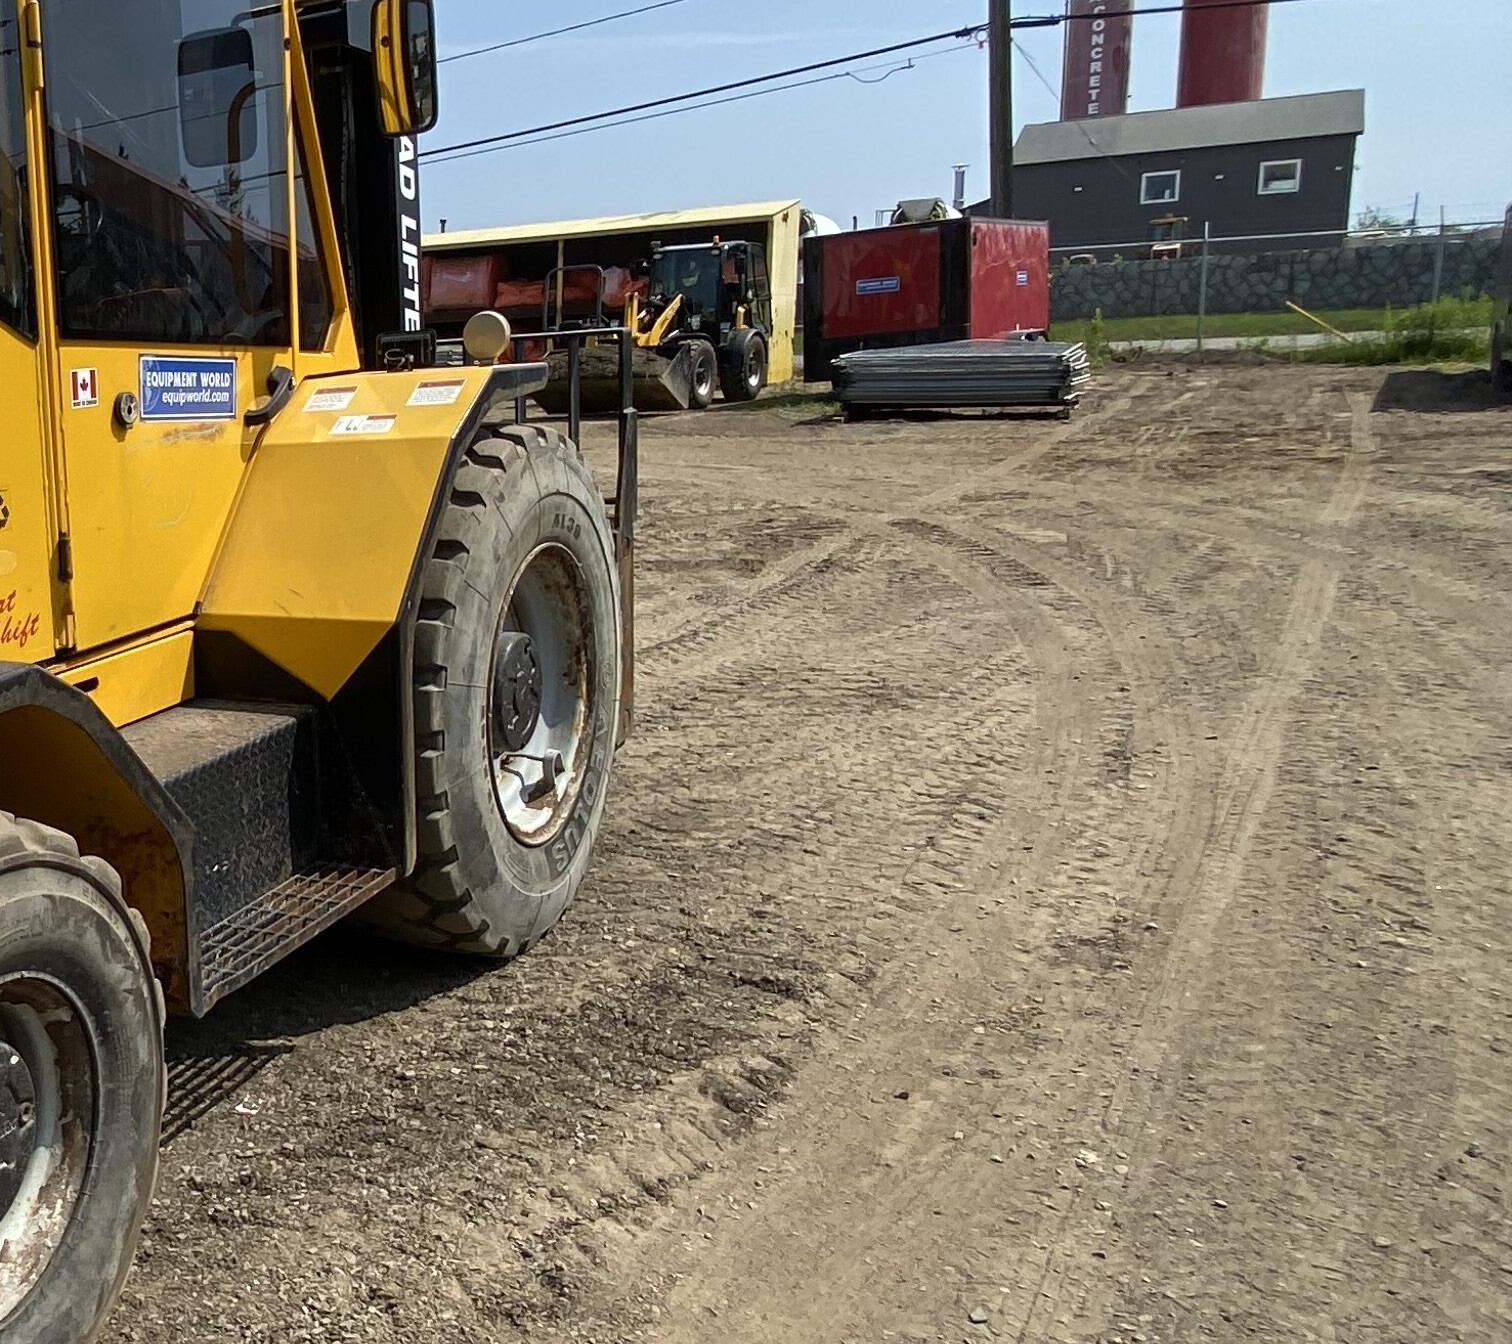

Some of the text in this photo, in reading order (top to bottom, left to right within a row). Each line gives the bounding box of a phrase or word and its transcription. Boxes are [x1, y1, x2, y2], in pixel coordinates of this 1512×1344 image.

[1087, 5, 1107, 116] CONCRETE
[400, 213, 421, 332] LIFTE
[145, 371, 231, 388] EQUIPMENT WORLD
[161, 388, 230, 407] equipworld.com
